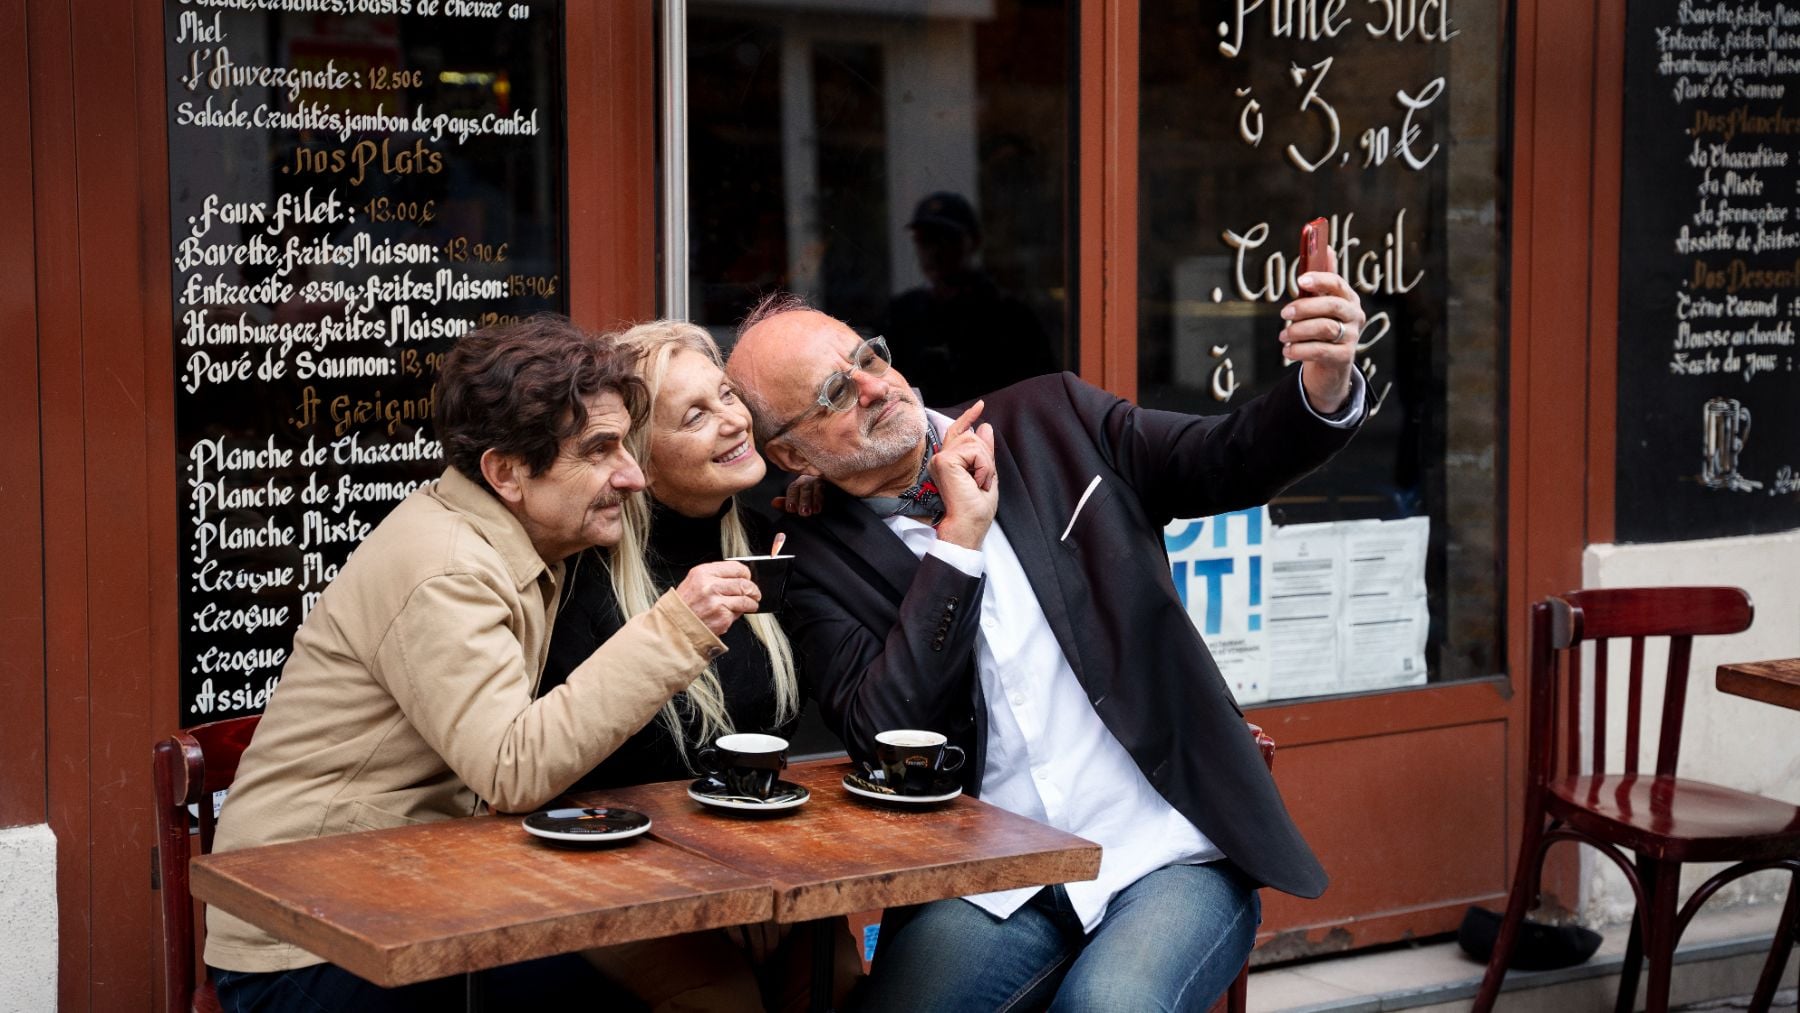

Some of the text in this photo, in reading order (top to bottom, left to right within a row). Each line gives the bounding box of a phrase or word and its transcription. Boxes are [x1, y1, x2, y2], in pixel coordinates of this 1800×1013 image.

[176, 10, 227, 44] Miel
[183, 272, 296, 306] Entrecôte
[185, 350, 253, 394] Pavé
[257, 347, 287, 382] de
[188, 434, 293, 486] Planche
[300, 435, 327, 467] de
[192, 476, 295, 525] Planche
[301, 472, 330, 504] de
[194, 510, 373, 564] Planche Mixte
[194, 602, 289, 634] Croque
[197, 646, 287, 676] Croque
